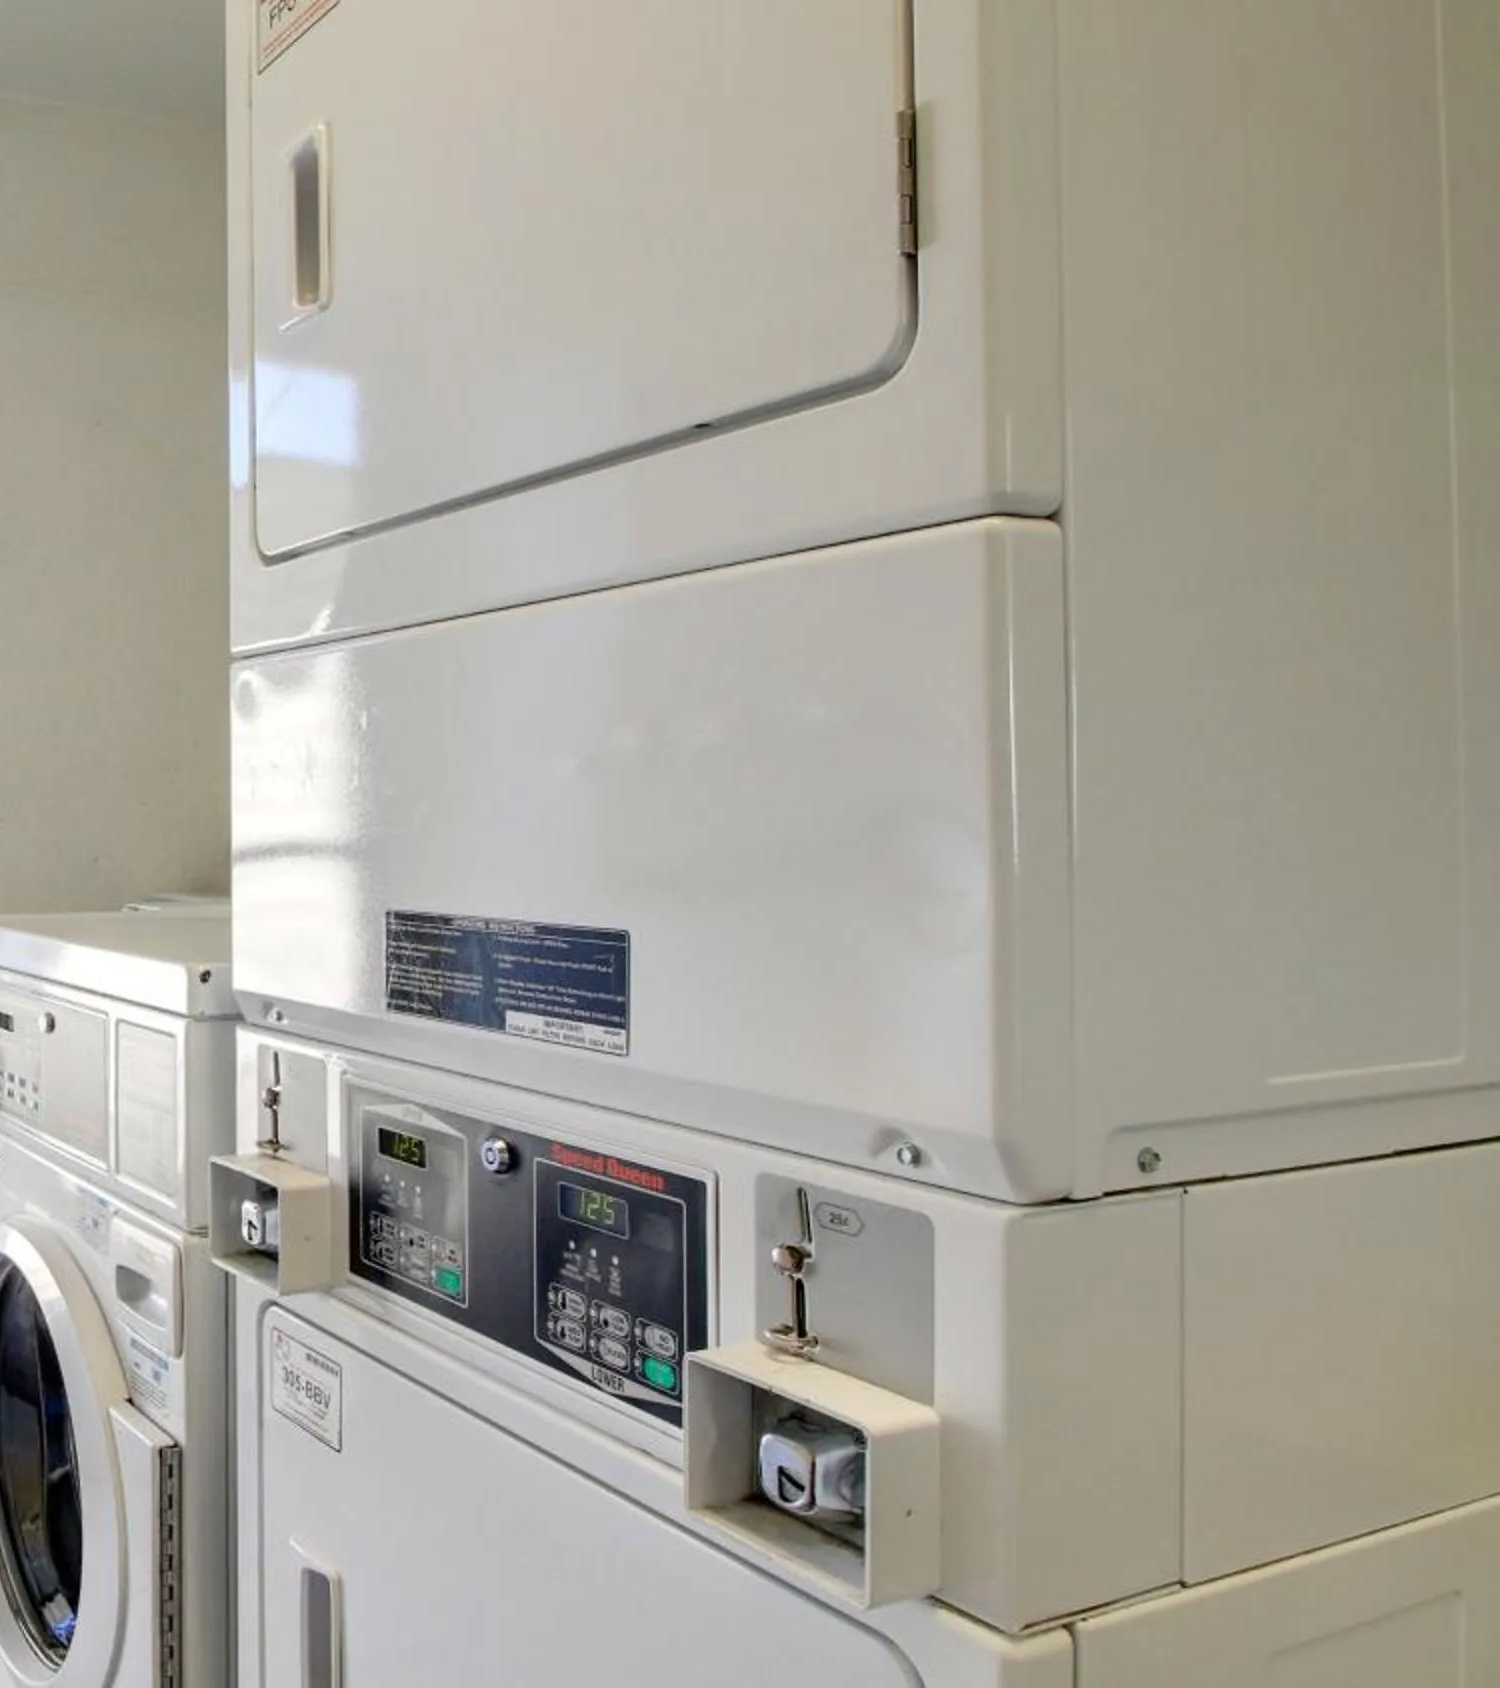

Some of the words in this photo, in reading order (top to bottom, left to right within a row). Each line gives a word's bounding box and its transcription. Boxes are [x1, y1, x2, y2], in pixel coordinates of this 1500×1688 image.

[552, 1141, 605, 1174] Speed
[607, 1158, 668, 1192] Queen
[580, 1191, 615, 1225] 125
[591, 1364, 626, 1393] LOWER
